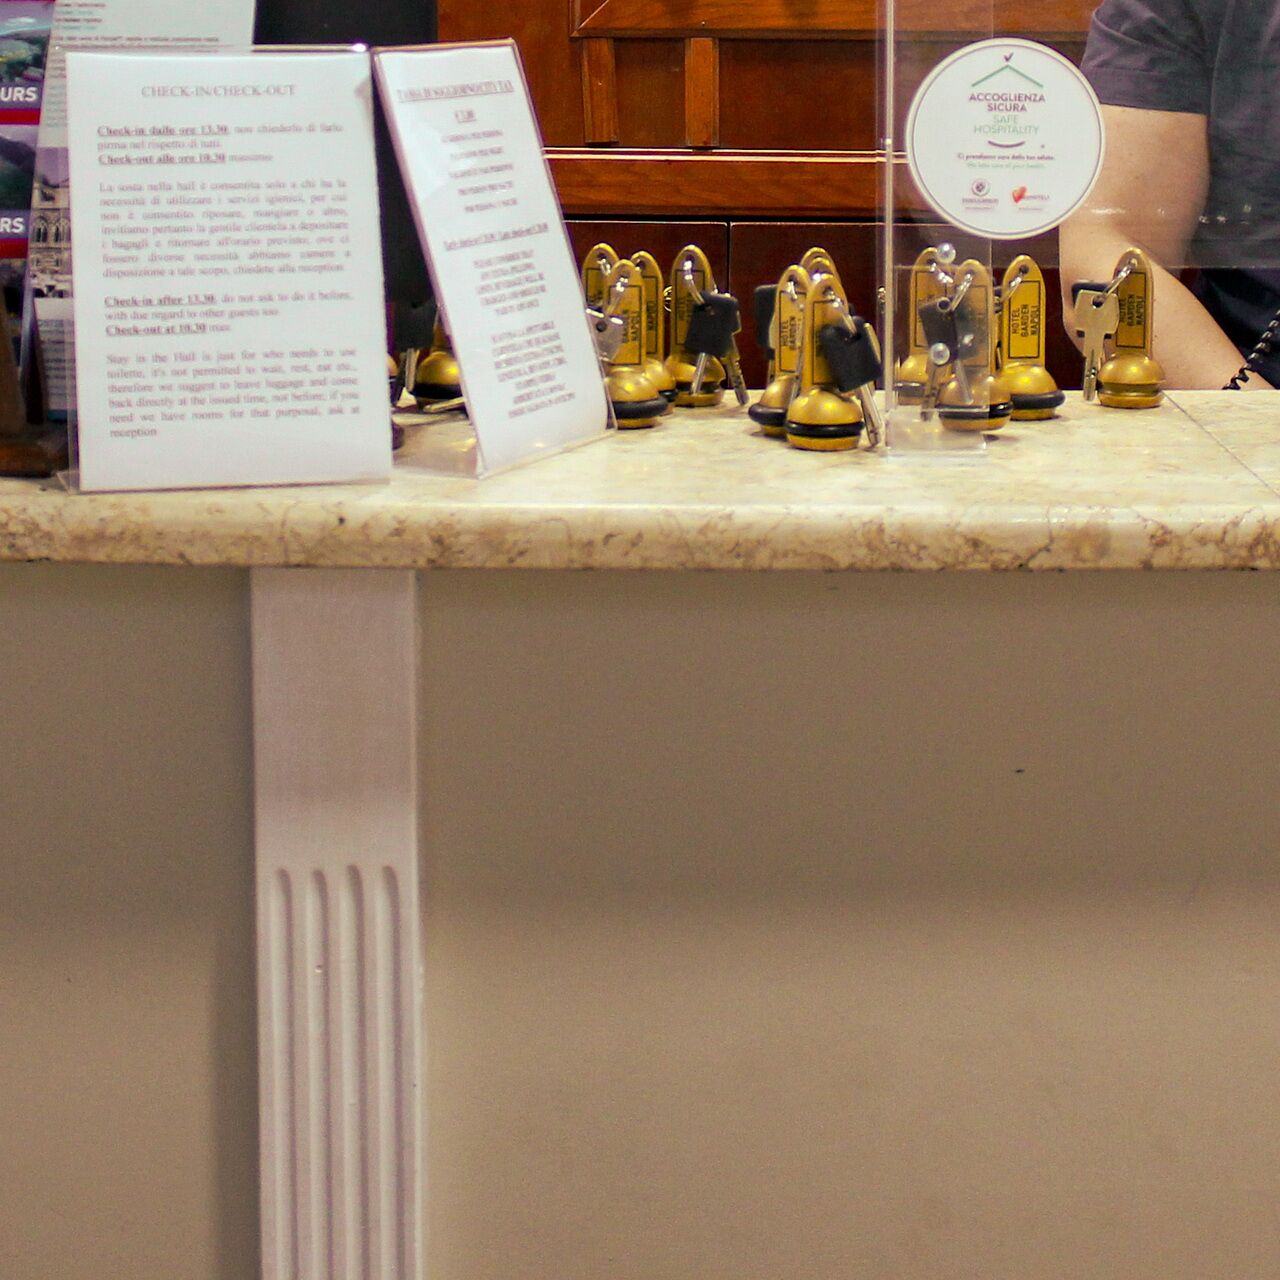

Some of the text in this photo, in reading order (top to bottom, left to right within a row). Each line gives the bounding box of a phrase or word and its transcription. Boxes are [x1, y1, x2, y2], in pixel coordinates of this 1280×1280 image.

[141, 84, 296, 97] CHECK-IN/CHECK-OUT
[969, 93, 1045, 102] ACCOGLIENZA
[987, 103, 1027, 112] SICURA
[993, 115, 1019, 123] SAFE
[97, 125, 145, 136] Check-in
[974, 125, 1039, 134] HOSPITALITY
[98, 154, 153, 165] Check-out
[104, 295, 182, 308] Check-in after
[1021, 304, 1029, 337] GARDEN
[1030, 305, 1039, 336] NAPOLI
[106, 325, 161, 337] Check-out
[165, 326, 178, 335] at
[781, 319, 789, 347] HOTEL
